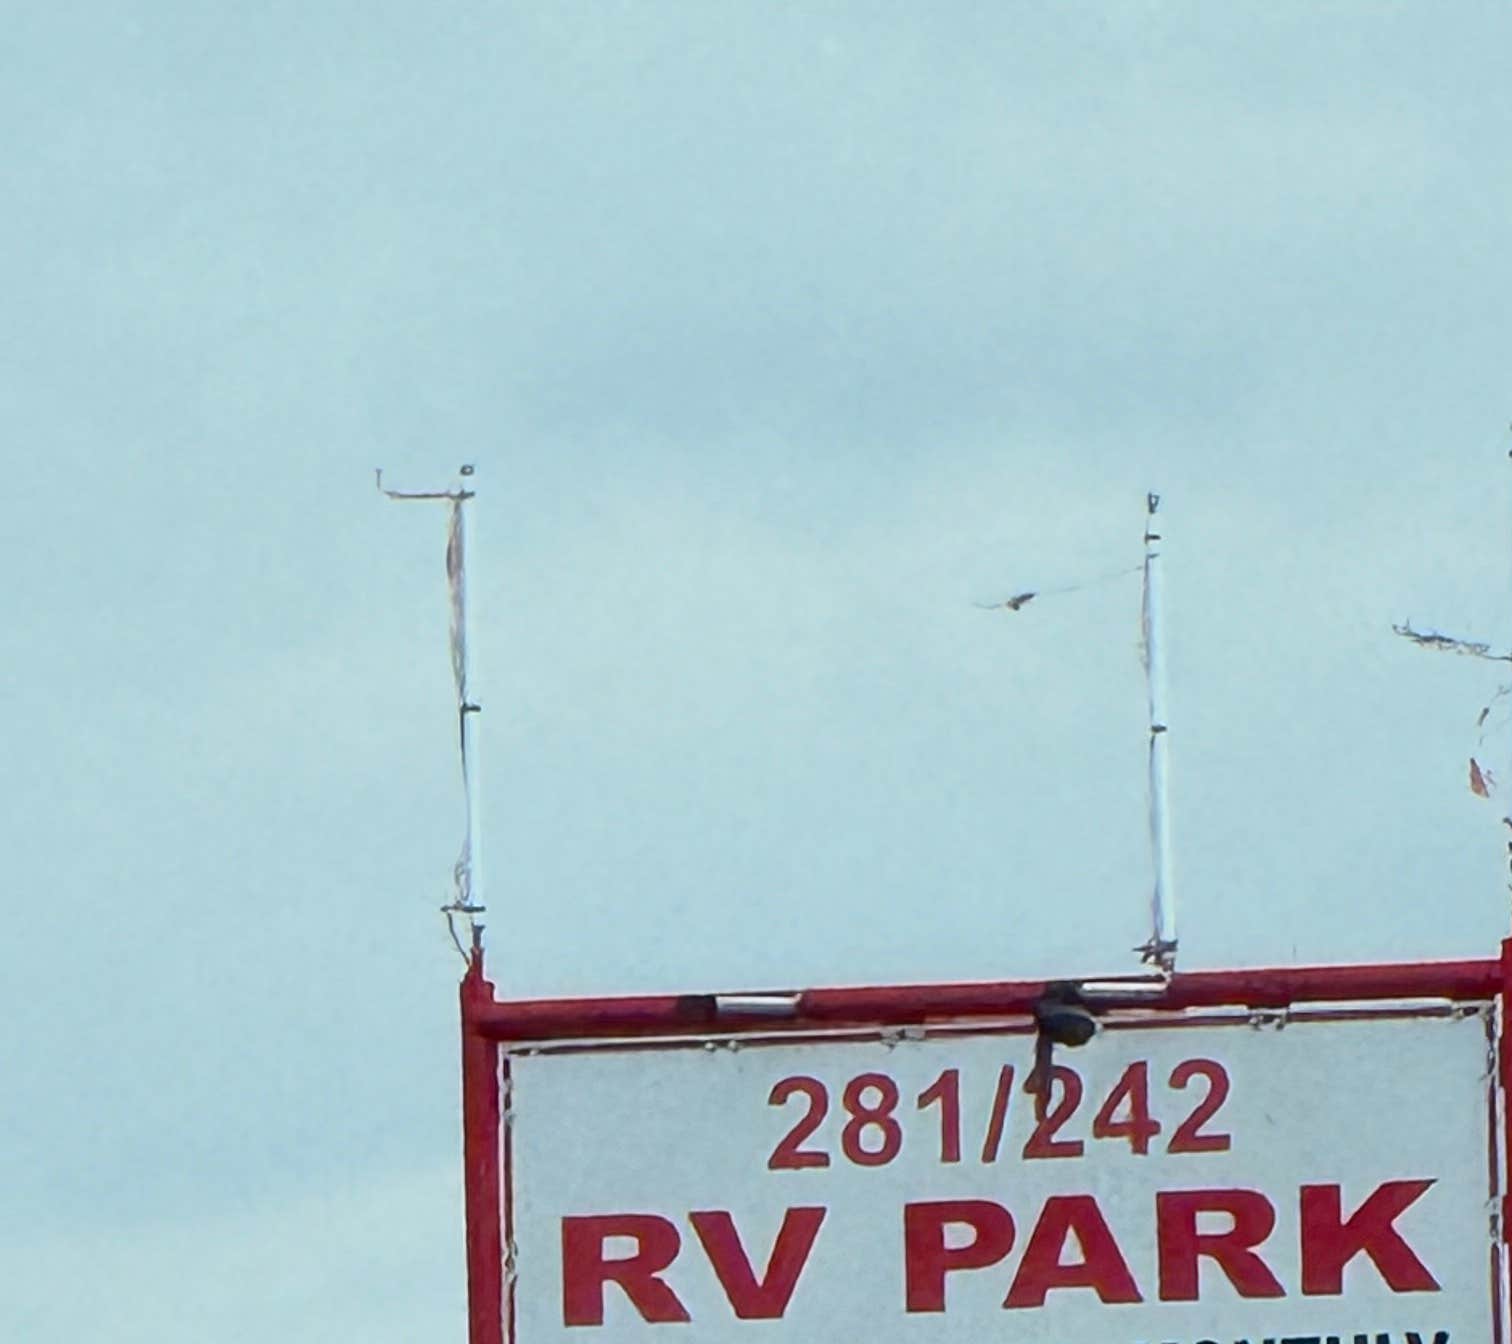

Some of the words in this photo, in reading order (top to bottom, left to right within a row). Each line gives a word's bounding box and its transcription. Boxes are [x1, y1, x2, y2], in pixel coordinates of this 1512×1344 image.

[769, 1059, 1232, 1170] 281/242
[560, 1205, 826, 1327] RV
[905, 1177, 1442, 1314] PARK
